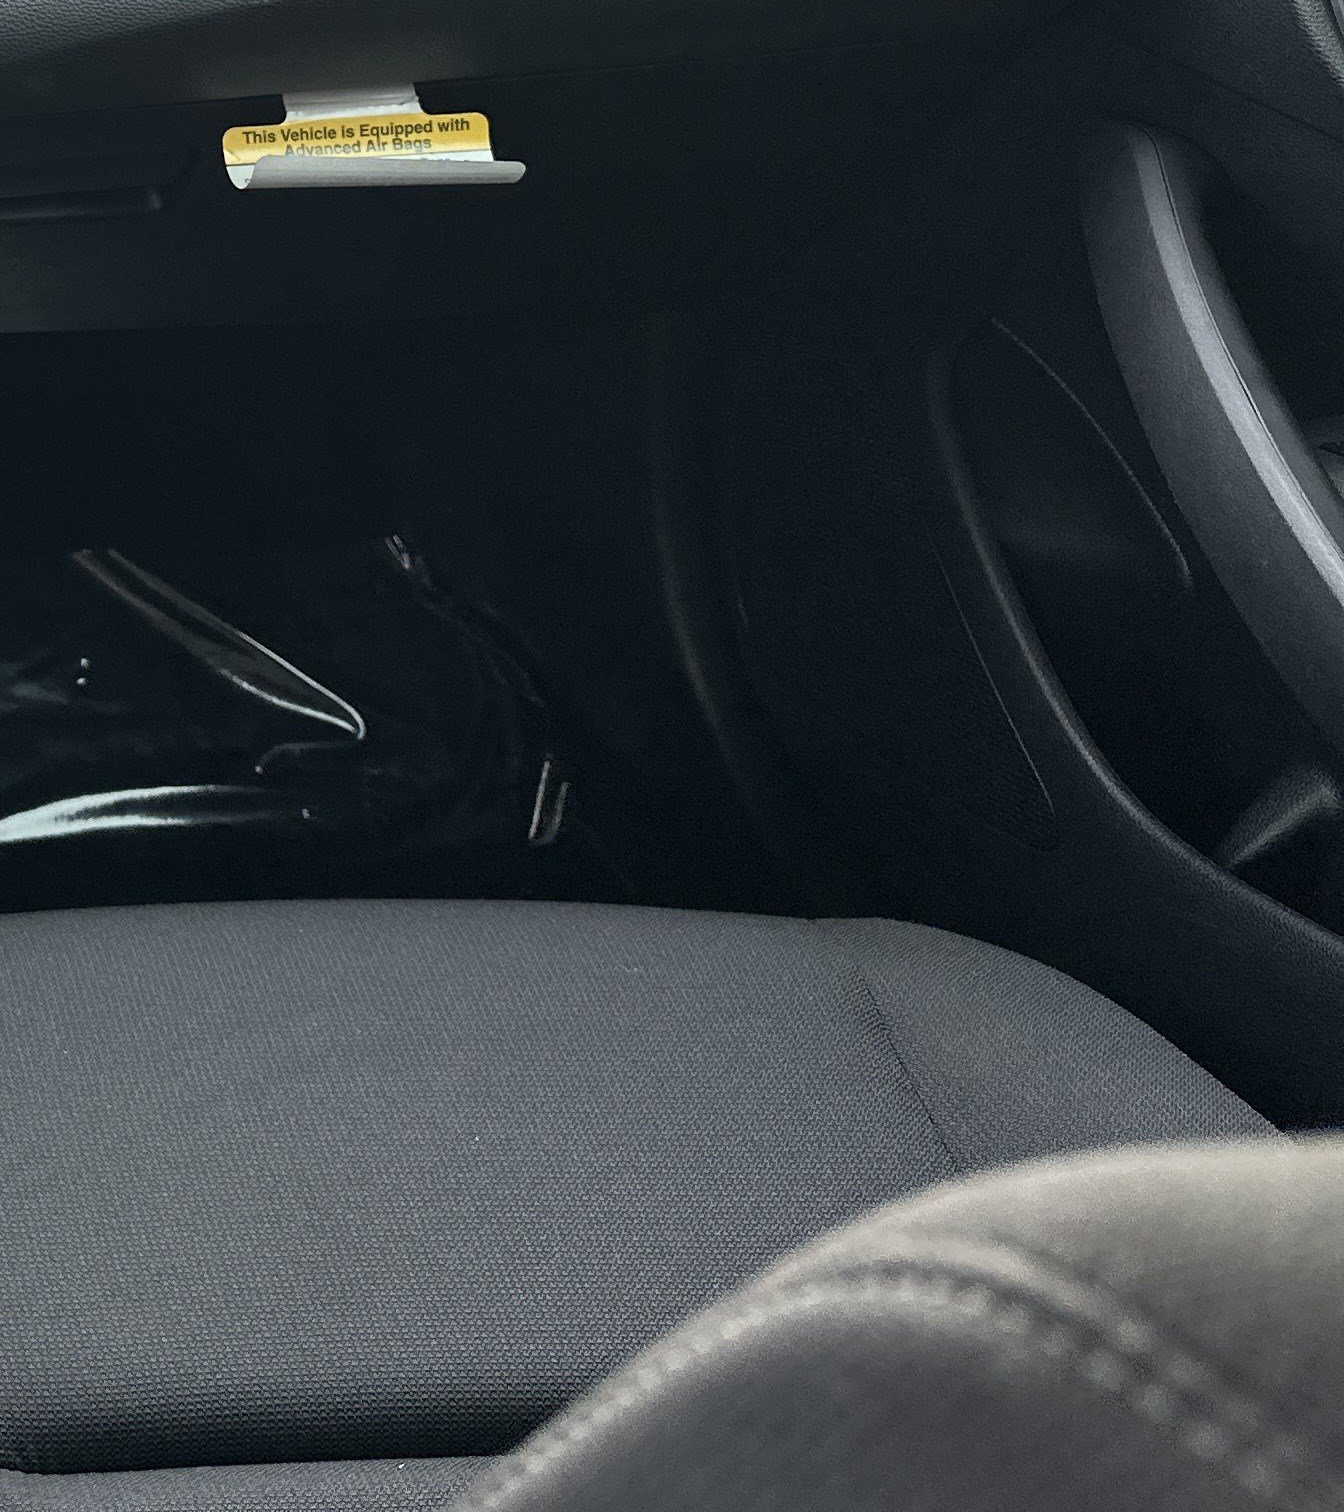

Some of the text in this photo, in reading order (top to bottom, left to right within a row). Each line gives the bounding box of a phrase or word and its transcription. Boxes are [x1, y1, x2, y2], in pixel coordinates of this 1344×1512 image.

[242, 130, 277, 145] This
[281, 126, 338, 143] Vehicle
[359, 120, 434, 140] Equipped
[438, 117, 470, 133] with
[285, 135, 432, 157] Advanced Air Bags
